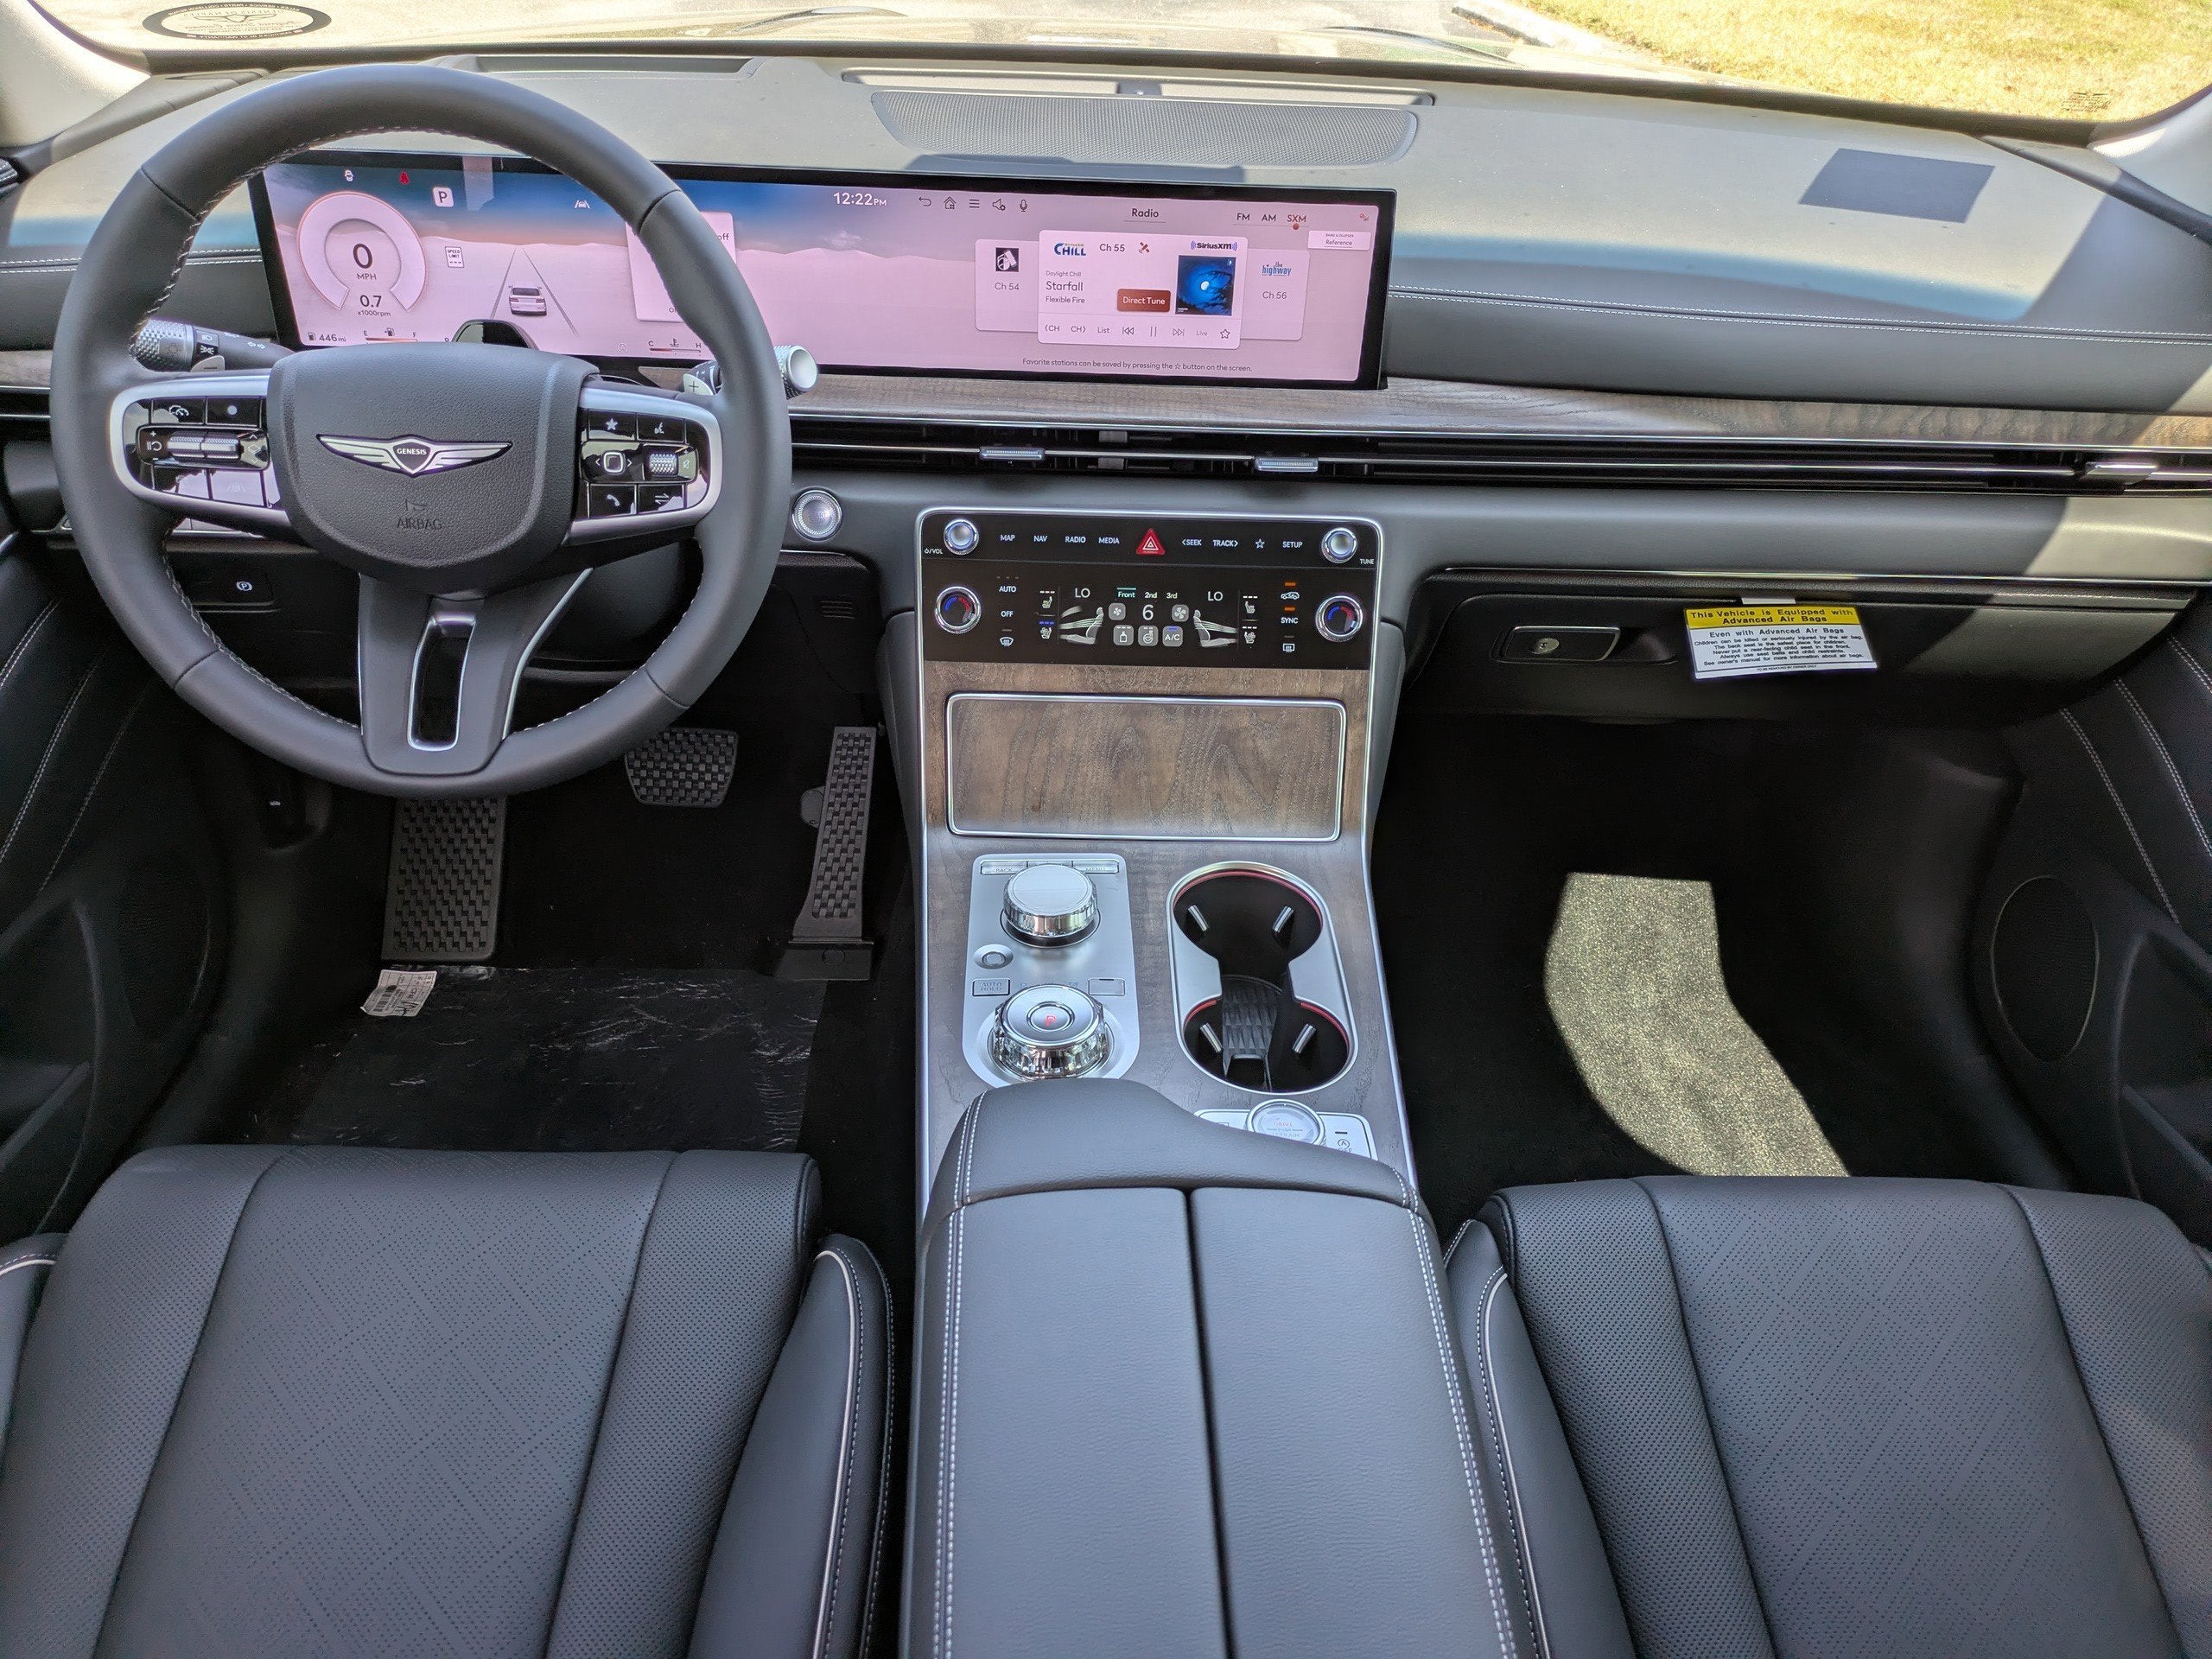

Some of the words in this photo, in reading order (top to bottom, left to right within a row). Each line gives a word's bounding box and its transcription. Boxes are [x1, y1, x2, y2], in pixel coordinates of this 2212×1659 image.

[438, 191, 448, 203] P
[1131, 208, 1159, 219] Radio
[1261, 213, 1276, 222] AM
[1287, 214, 1307, 223] SXM
[1054, 243, 1086, 256] CHILL
[353, 243, 373, 269] 0
[1262, 264, 1292, 276] highway
[1046, 281, 1084, 291] Starfall
[359, 295, 382, 308] 0.7
[397, 518, 442, 530] AIRBAG
[1075, 588, 1091, 599] LO
[1207, 591, 1224, 601] LO
[1142, 605, 1154, 620] 6
[1046, 1015, 1057, 1027] P
